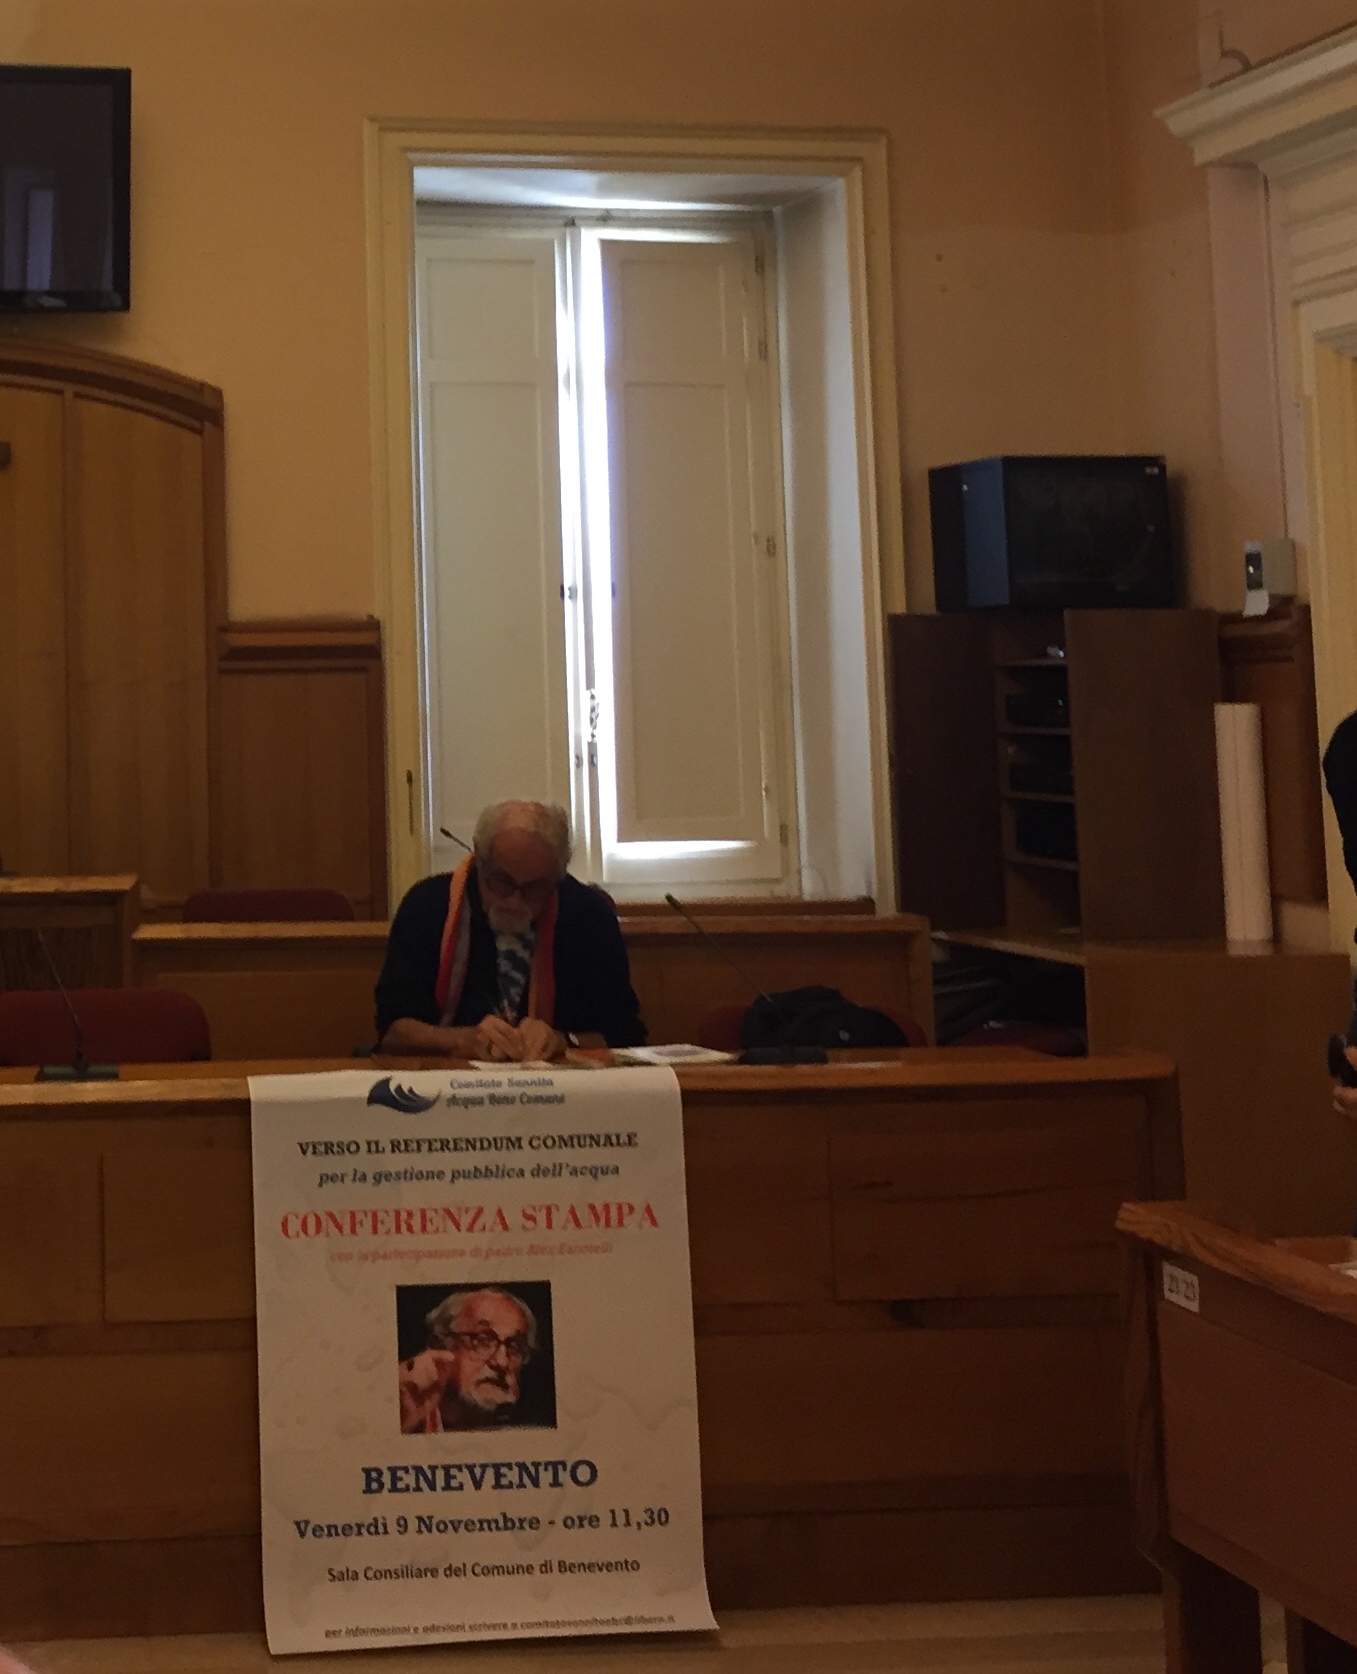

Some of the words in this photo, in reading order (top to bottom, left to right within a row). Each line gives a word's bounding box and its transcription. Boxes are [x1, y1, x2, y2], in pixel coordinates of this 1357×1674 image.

[297, 1139, 360, 1157] VERSO
[365, 1139, 385, 1154] IL
[390, 1136, 523, 1154] REFERENDUM
[528, 1132, 638, 1149] COMUNALE
[318, 1170, 347, 1187] per
[351, 1167, 368, 1184] la
[372, 1166, 445, 1187] gestione
[449, 1163, 525, 1184] pubblica
[530, 1162, 620, 1181] dell'acqua
[280, 1205, 510, 1240] CONFERENZA
[521, 1200, 659, 1232] STAMPA
[361, 1459, 599, 1494] BENEVENTO
[293, 1517, 390, 1539] Venerdì
[395, 1516, 408, 1535] 9
[416, 1512, 540, 1535] Novembre
[562, 1512, 600, 1531] ore
[609, 1507, 670, 1532] 11,30
[328, 1567, 359, 1583] Sala
[363, 1564, 439, 1581] Consiliare
[443, 1562, 467, 1578] del
[471, 1561, 534, 1577] Comune
[539, 1559, 553, 1575] di
[557, 1557, 640, 1574] Benevento
